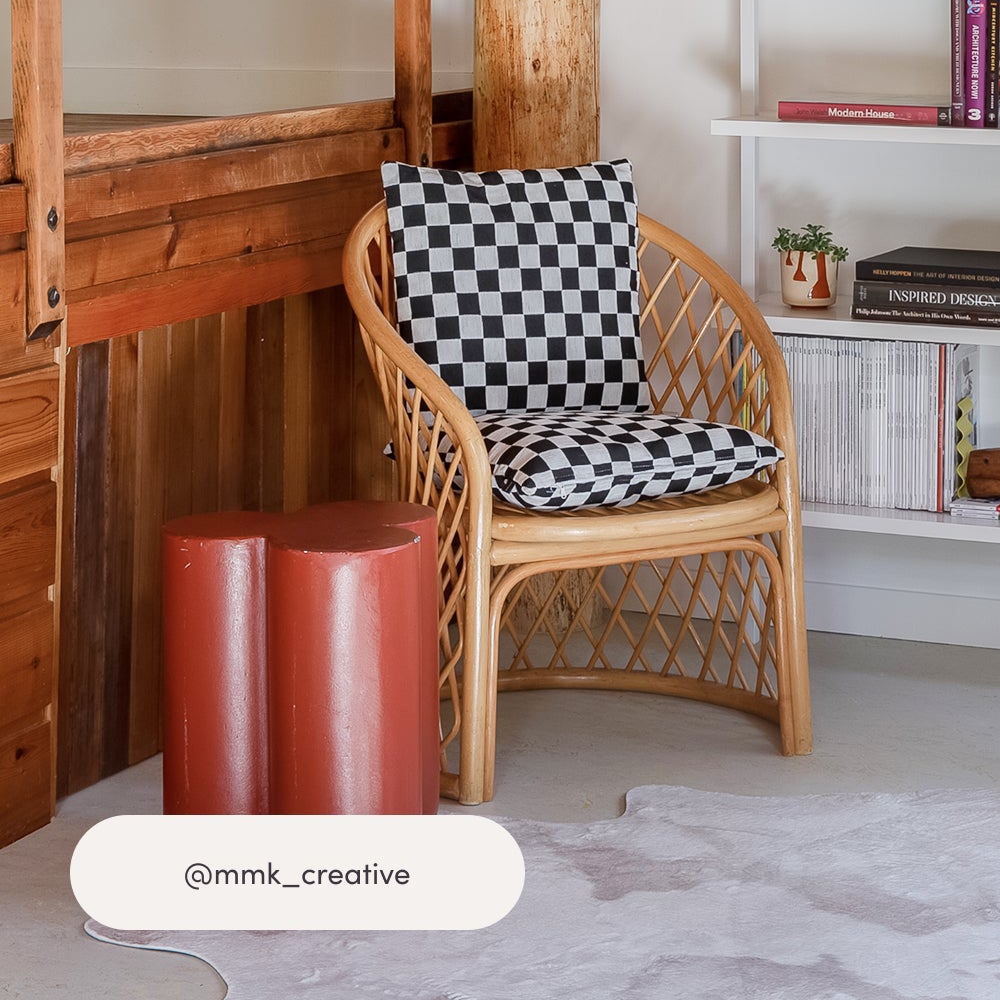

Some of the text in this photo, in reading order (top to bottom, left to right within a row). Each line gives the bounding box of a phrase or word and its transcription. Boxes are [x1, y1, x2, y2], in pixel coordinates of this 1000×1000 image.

[971, 25, 980, 100] ARCHITECTURE NOW!
[828, 107, 895, 119] Modern House
[889, 289, 998, 308] INSPIRED DESIGN
